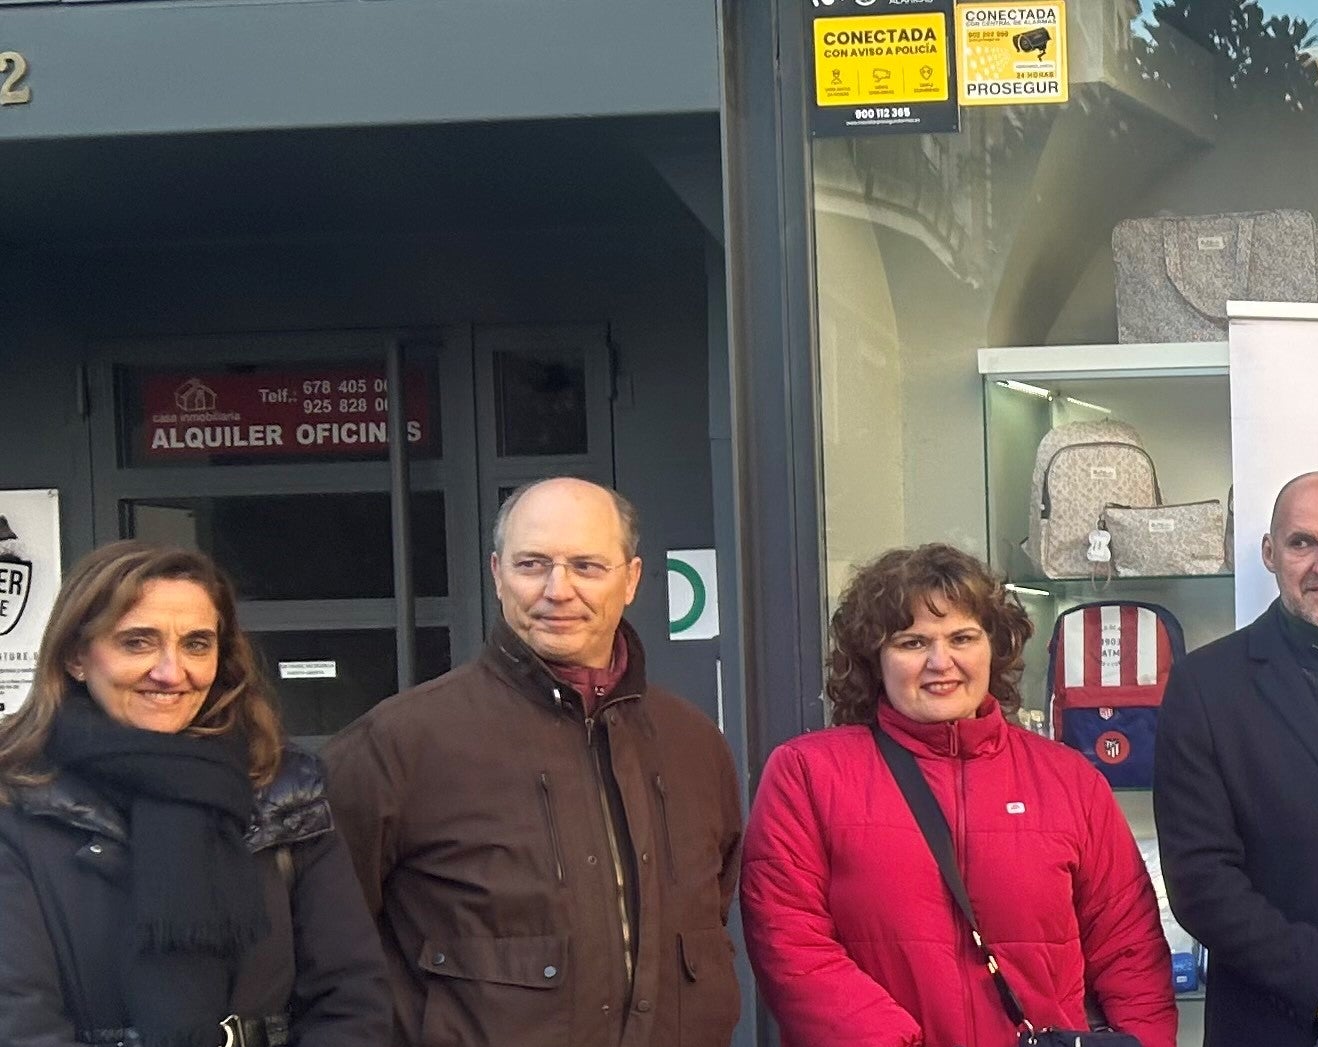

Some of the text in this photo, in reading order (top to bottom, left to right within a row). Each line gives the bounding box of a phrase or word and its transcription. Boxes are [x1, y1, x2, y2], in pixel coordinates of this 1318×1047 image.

[966, 8, 1056, 21] CONECTADA
[823, 27, 937, 45] CONECTADA
[824, 43, 937, 58] CON AVISO A POLICÍA
[0, 51, 30, 105] 2
[967, 81, 1058, 96] PROSEGUR
[303, 380, 331, 395] 678
[338, 379, 367, 393] 405
[303, 399, 332, 413] 925
[339, 398, 367, 412] 828
[152, 420, 421, 449] ALQUILER OFICINS
